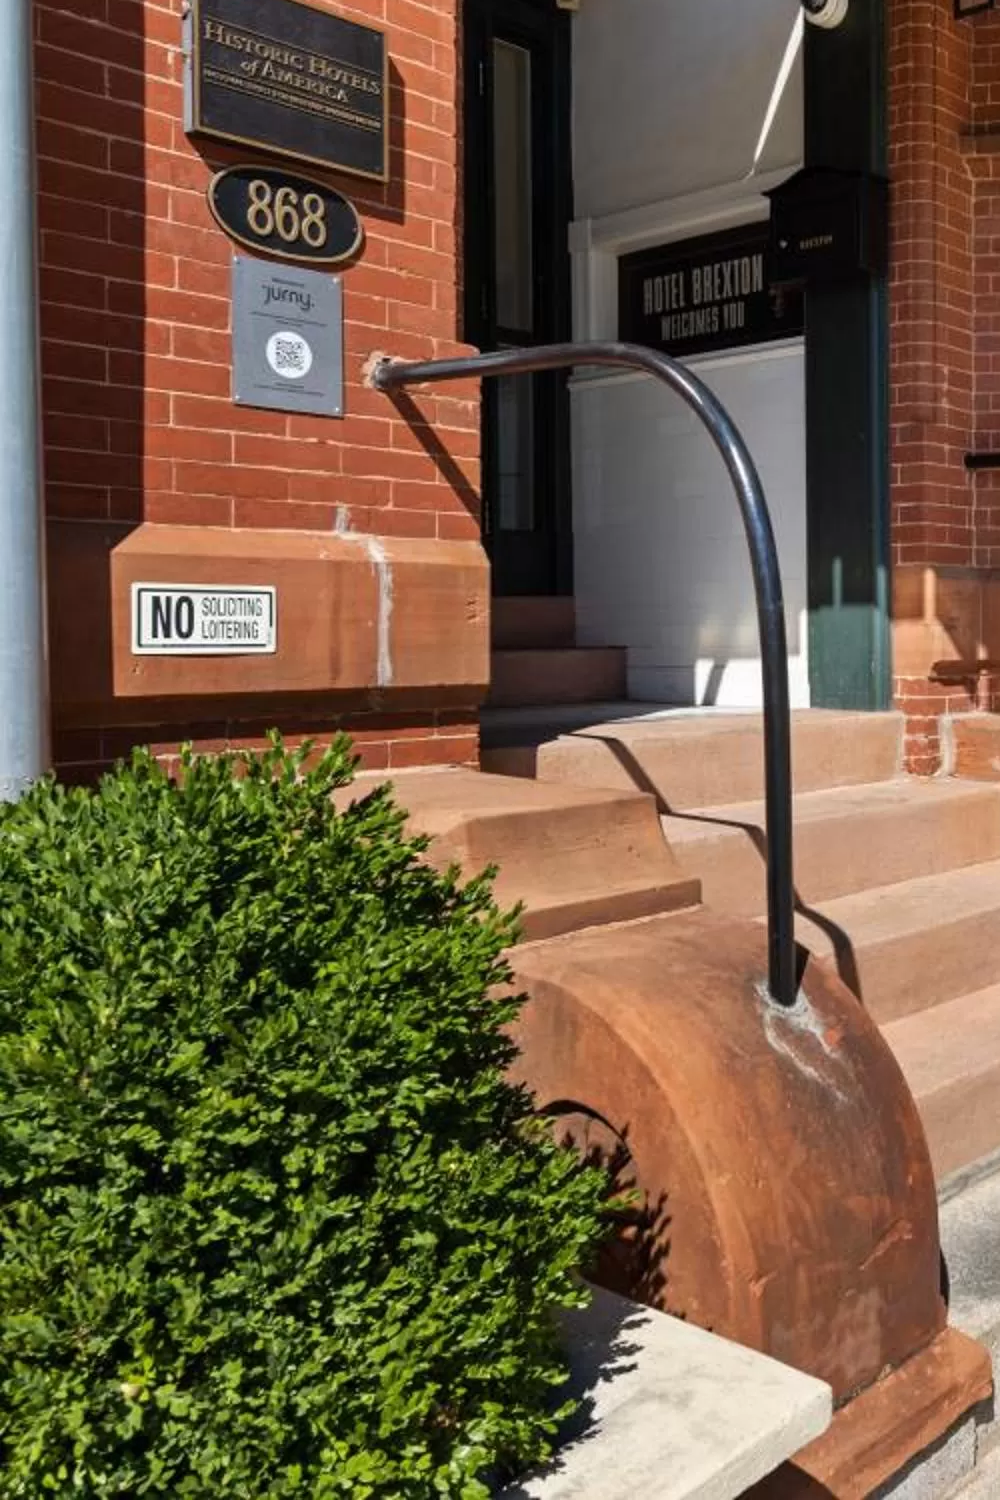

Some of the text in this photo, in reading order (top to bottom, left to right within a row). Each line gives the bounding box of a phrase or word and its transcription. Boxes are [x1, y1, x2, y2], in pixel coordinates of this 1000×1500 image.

[240, 59, 260, 78] of
[247, 179, 327, 248] 868
[643, 253, 764, 316] HOTEL BREXTON
[661, 301, 746, 341] WELCOMES YOU
[151, 595, 263, 639] NO SOLICITING
[202, 620, 260, 639] LOITERING
